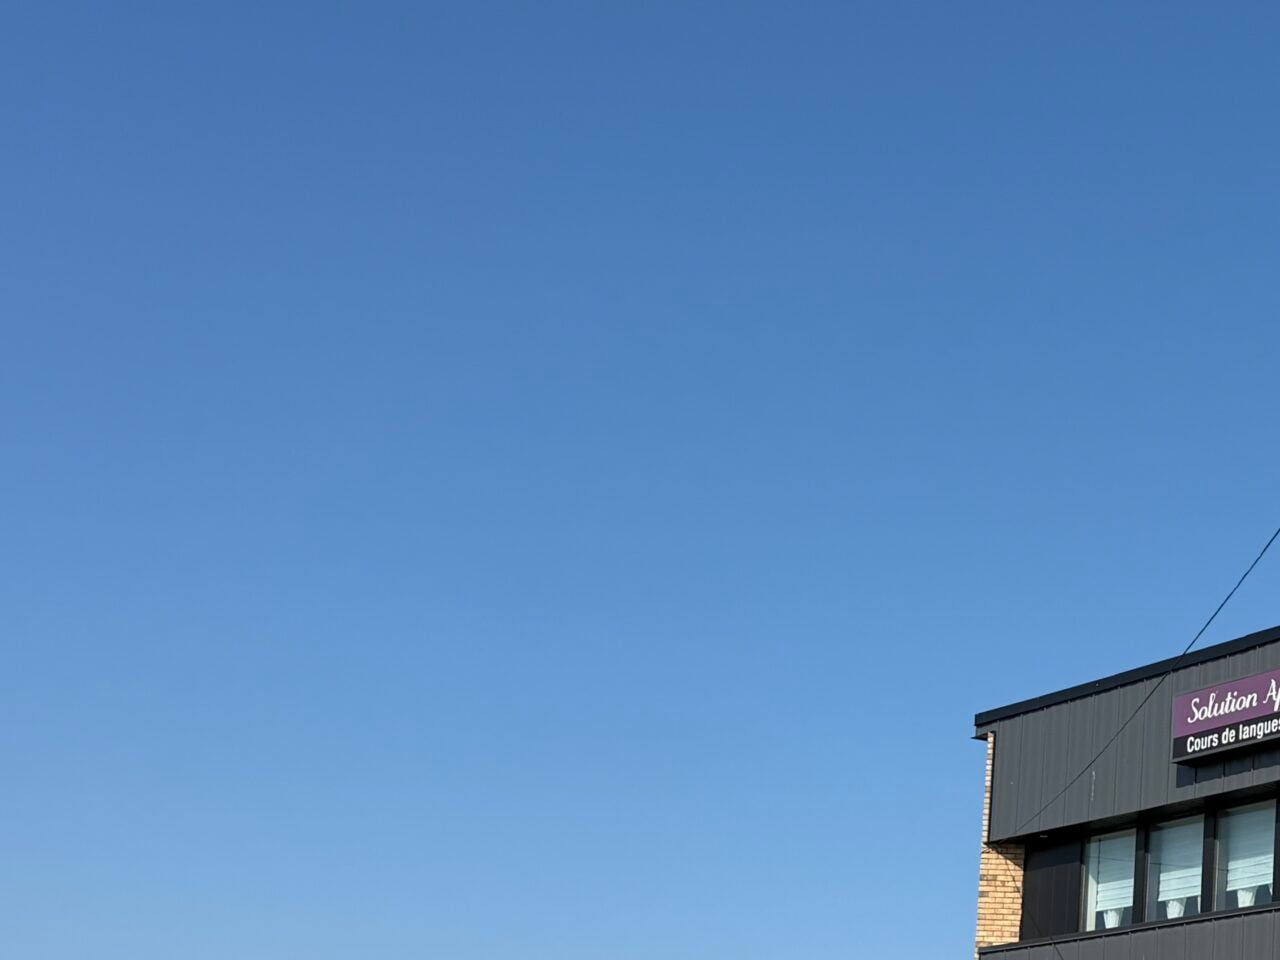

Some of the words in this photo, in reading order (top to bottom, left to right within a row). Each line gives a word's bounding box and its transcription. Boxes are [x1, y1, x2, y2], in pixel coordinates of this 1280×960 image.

[1187, 690, 1258, 724] Solution
[1186, 733, 1219, 753] Cours
[1221, 727, 1236, 745] de
